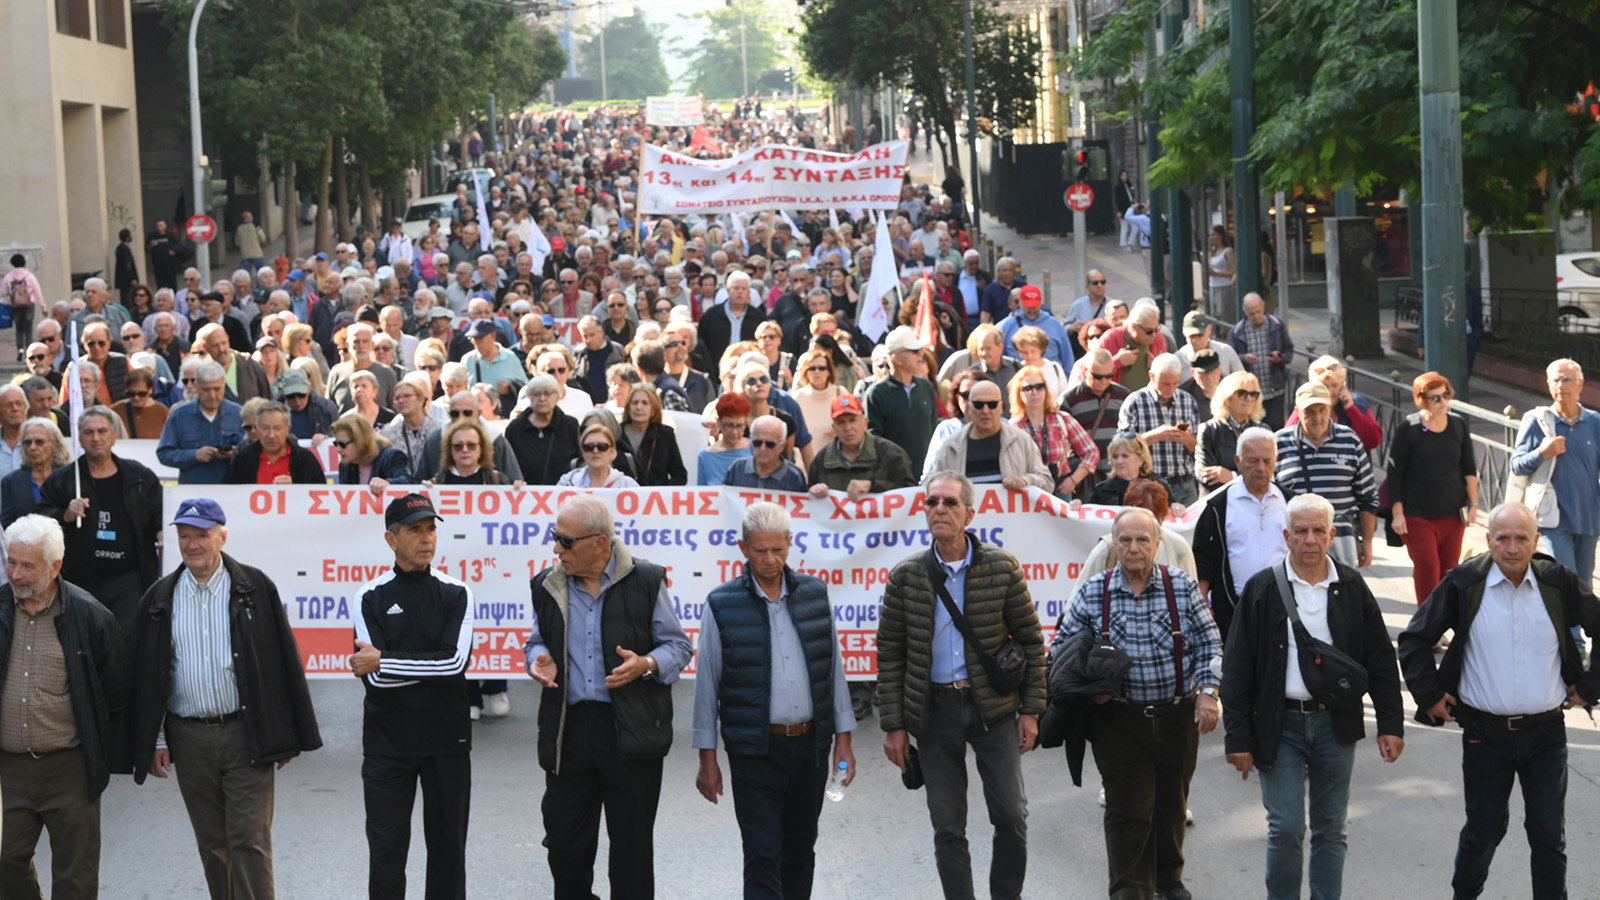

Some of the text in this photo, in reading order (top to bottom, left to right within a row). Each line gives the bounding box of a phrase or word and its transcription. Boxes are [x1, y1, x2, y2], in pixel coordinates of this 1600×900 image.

[691, 179, 717, 188] και
[773, 164, 906, 183] ΣΥΝΤΑΞΗΣ
[249, 490, 286, 515] ΟΙ
[308, 490, 594, 516] ΣΥΝΞΙΟΥΧ
[616, 490, 720, 516] ΟΛΗΣ
[830, 491, 928, 520] ΧΩΡΑ
[978, 488, 1201, 525] ΑΠΑΙΤΟΕ
[614, 519, 698, 552] ήσεις
[708, 528, 738, 547] σε
[818, 532, 856, 555] τις
[865, 527, 1004, 549] συντις
[296, 596, 350, 620] ΤΩΡΑ
[306, 654, 354, 671] ΔΗΜΟ
[842, 656, 871, 672] ΩΝ
